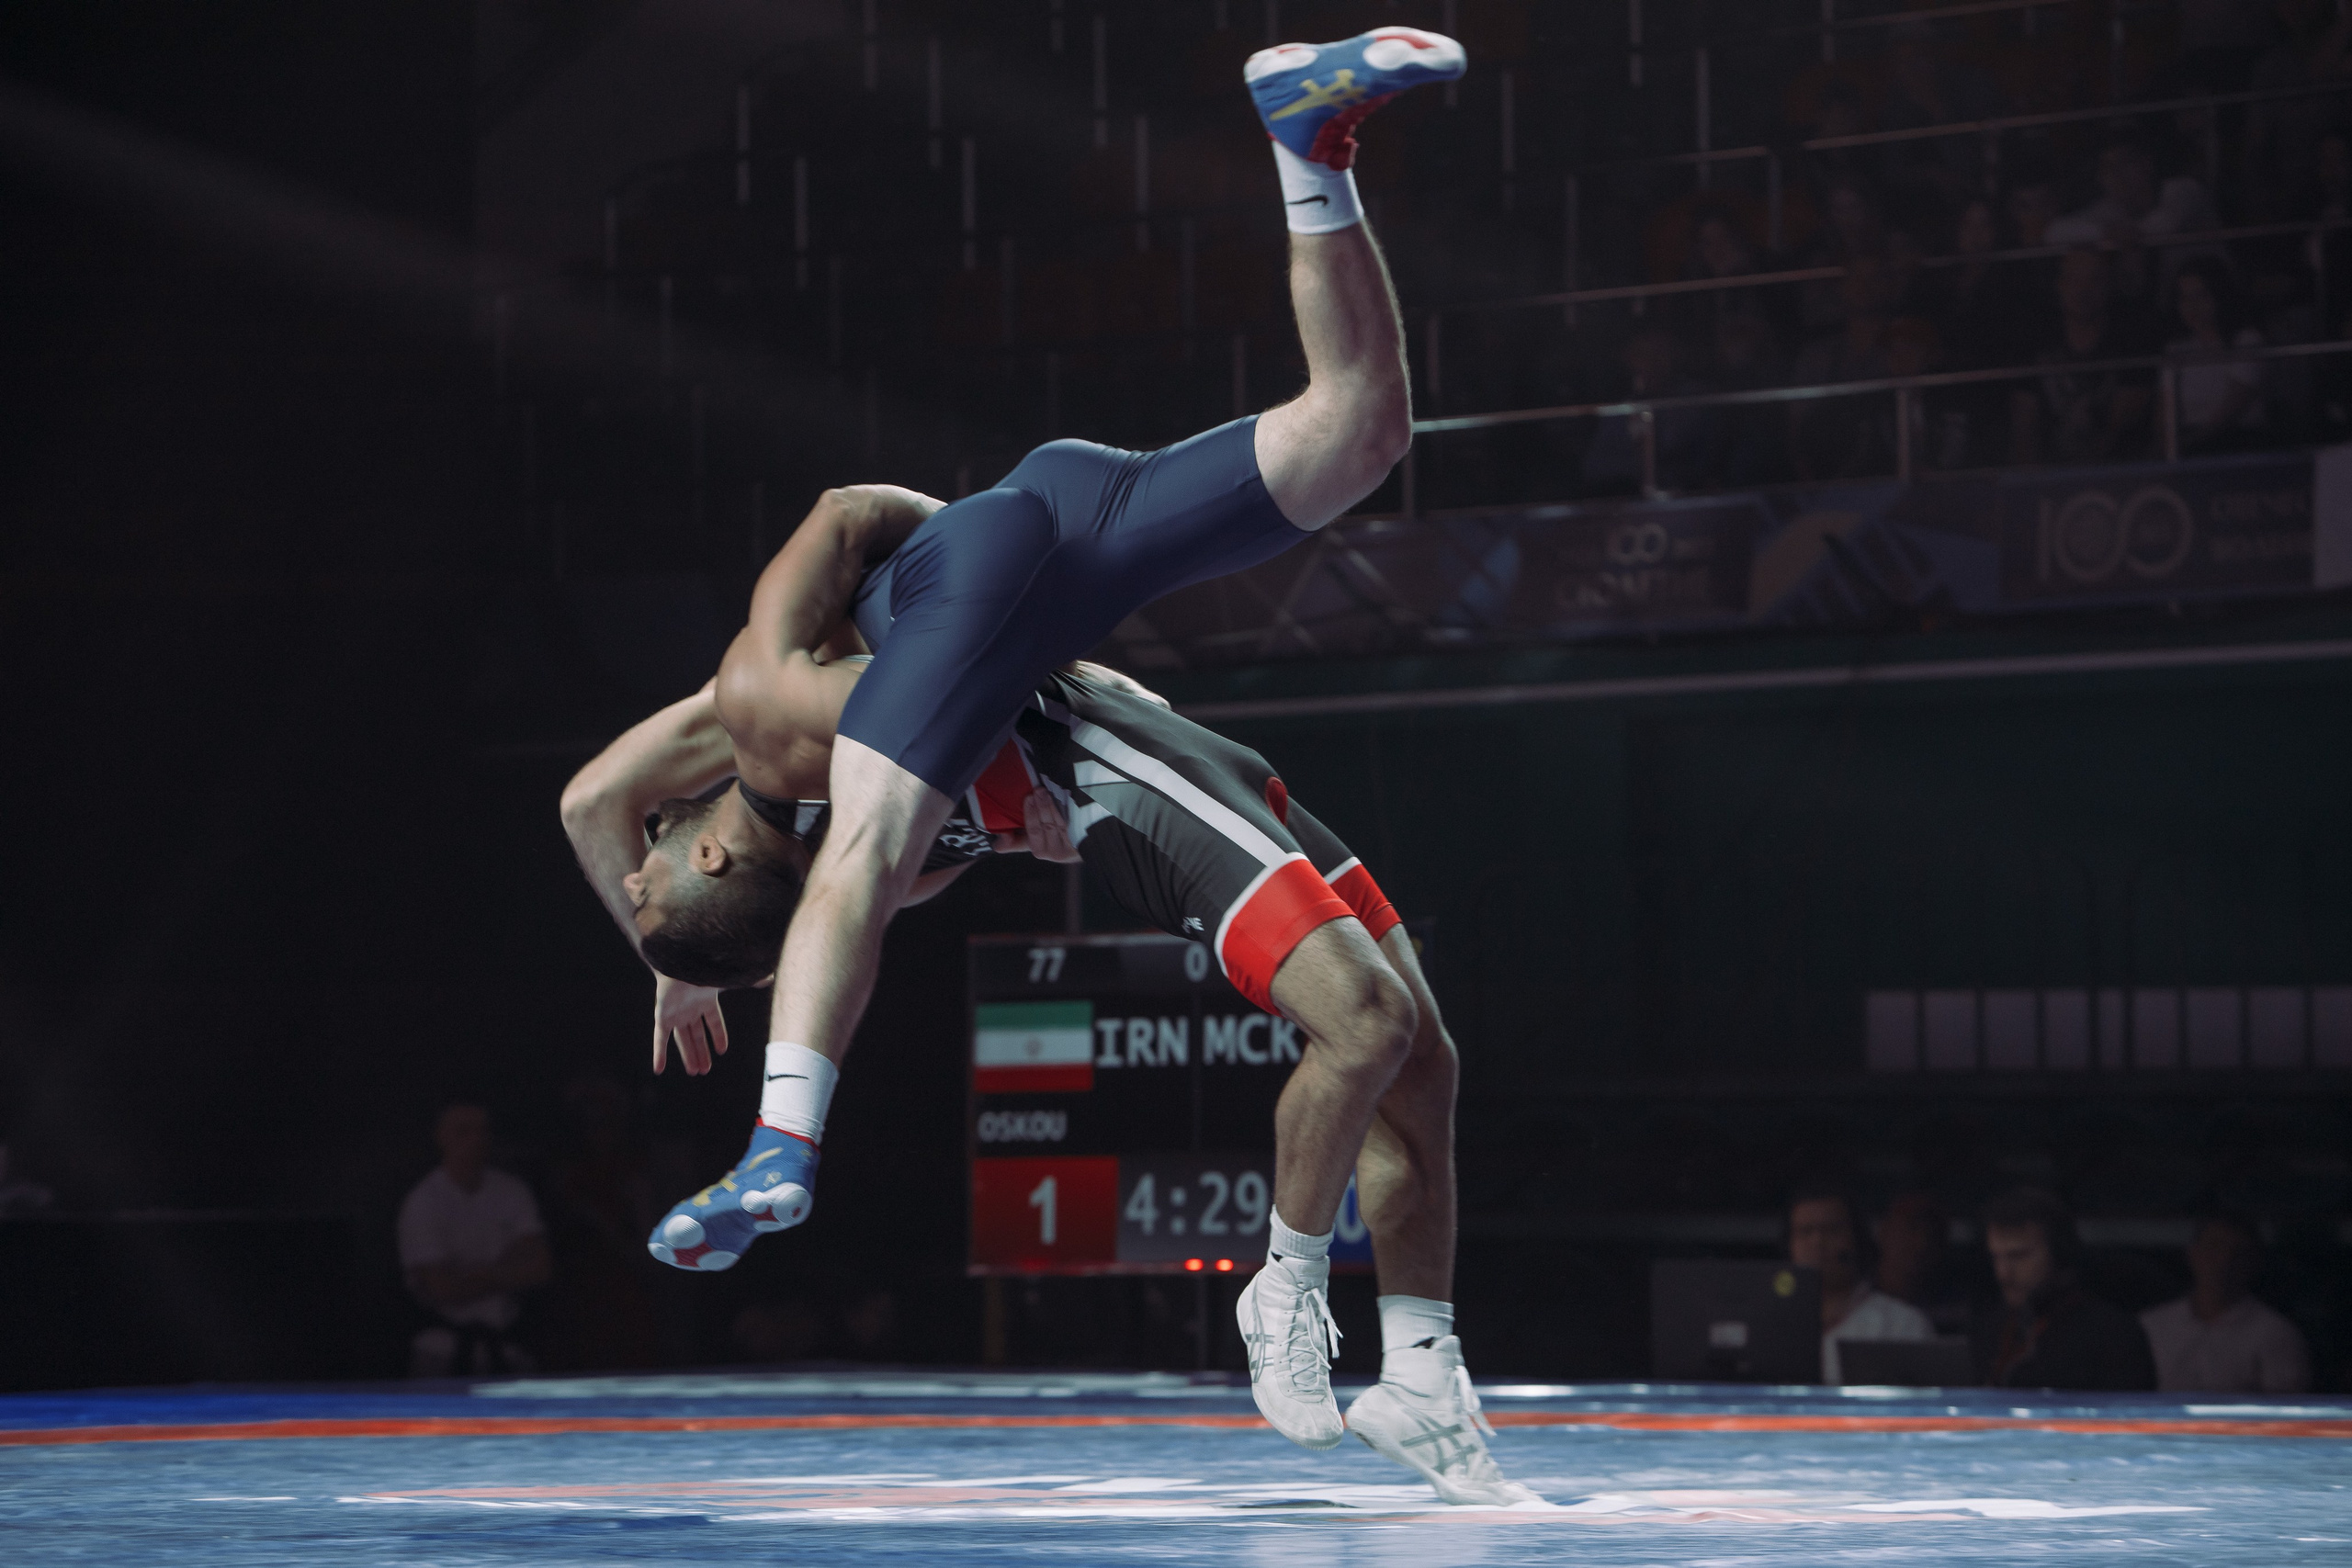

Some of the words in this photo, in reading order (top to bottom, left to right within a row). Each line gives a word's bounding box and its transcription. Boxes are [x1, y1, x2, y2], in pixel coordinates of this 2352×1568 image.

[1028, 948, 1067, 983] 77
[1184, 942, 1208, 982] 0
[1096, 1016, 1190, 1066] IRN
[1028, 1174, 1057, 1245] 1
[1124, 1171, 1269, 1235] 4:29
